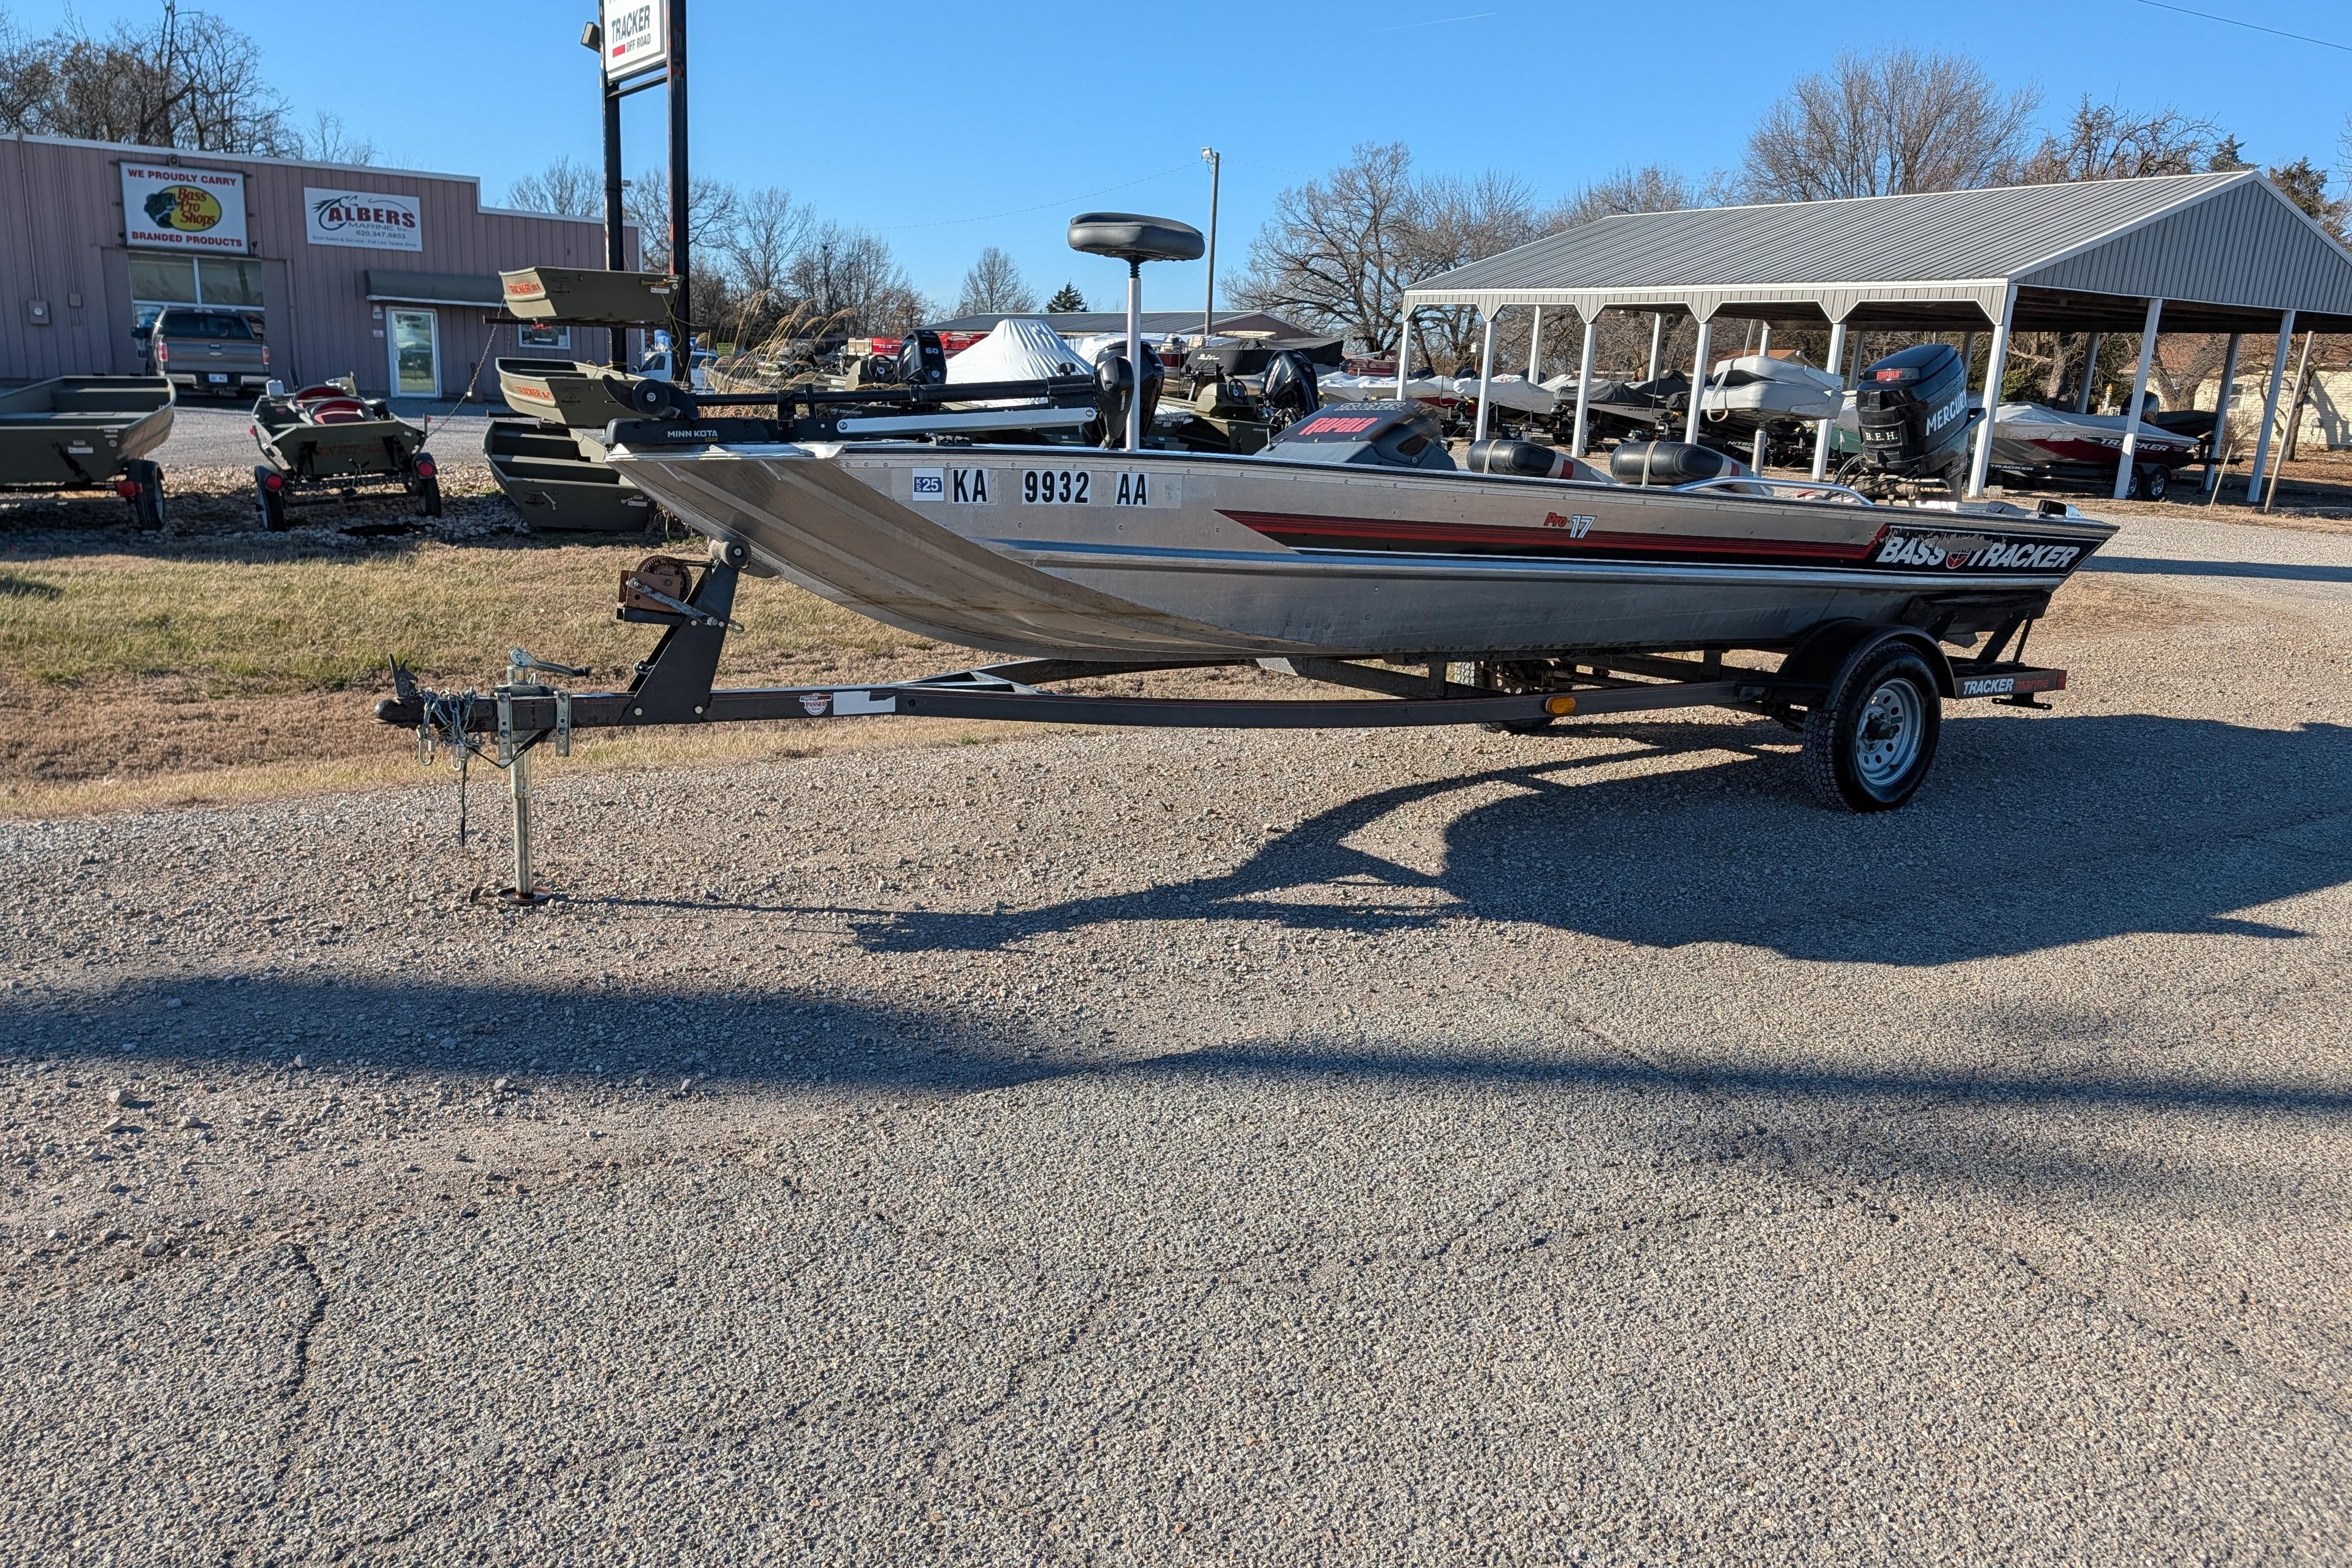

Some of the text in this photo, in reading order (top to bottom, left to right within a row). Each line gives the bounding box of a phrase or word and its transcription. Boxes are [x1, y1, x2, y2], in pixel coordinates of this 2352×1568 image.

[612, 5, 650, 44] TRACKER
[627, 33, 651, 52] OFF ROAD
[128, 169, 236, 186] WE PROUDLY CARRY
[178, 187, 208, 202] Bass
[179, 201, 200, 213] Pro
[180, 212, 216, 227] Shops
[328, 207, 416, 228] ALBERS
[348, 222, 394, 231] MARINE
[131, 231, 243, 247] BRANDED PRODUCTS
[1334, 402, 1407, 411] TRACKER
[1925, 390, 1967, 436] MERCURY
[693, 429, 718, 438] KOTA
[2101, 438, 2169, 451] TRCKER
[953, 469, 1147, 505] KA 9932 AA
[1543, 512, 1597, 539] Pro 17
[1876, 537, 1946, 566] BASS
[1963, 677, 2049, 695] TRACKER marine
